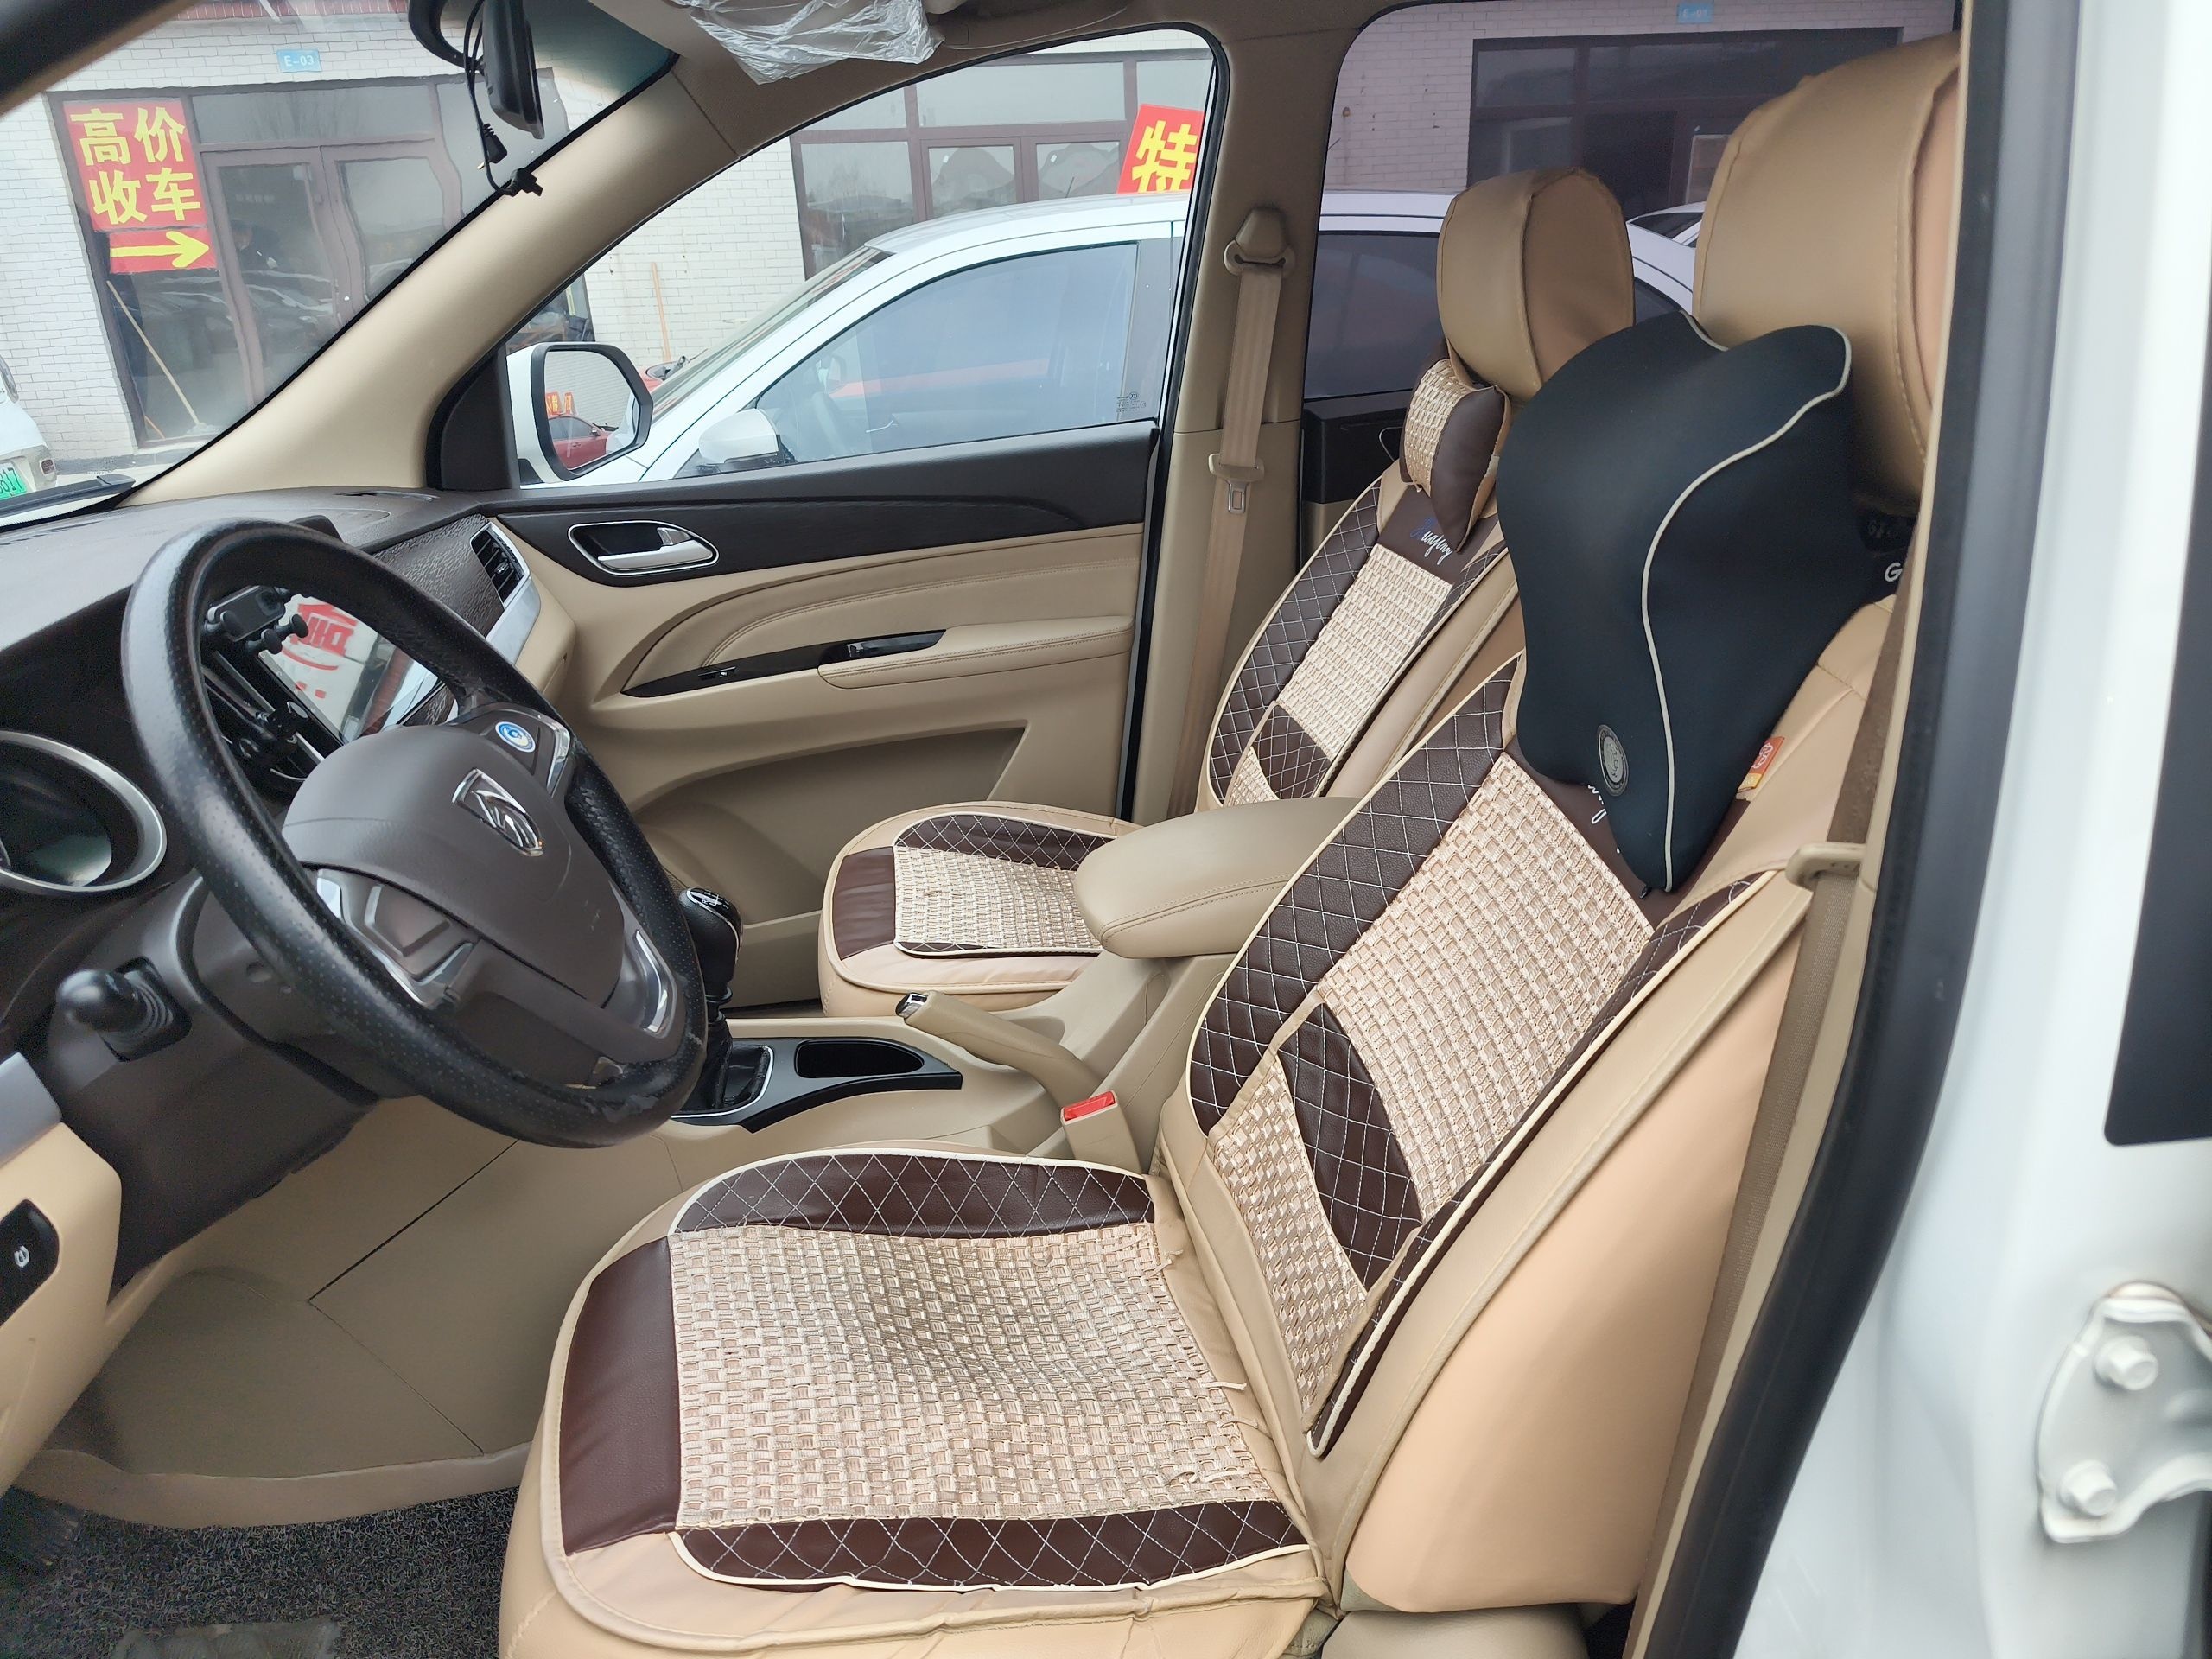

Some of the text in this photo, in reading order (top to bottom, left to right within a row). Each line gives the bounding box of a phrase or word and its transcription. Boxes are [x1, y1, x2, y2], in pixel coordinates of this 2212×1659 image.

[283, 54, 315, 67] E-03
[70, 106, 185, 166] 高价
[1131, 119, 1198, 194] 特
[88, 167, 201, 225] 收车
